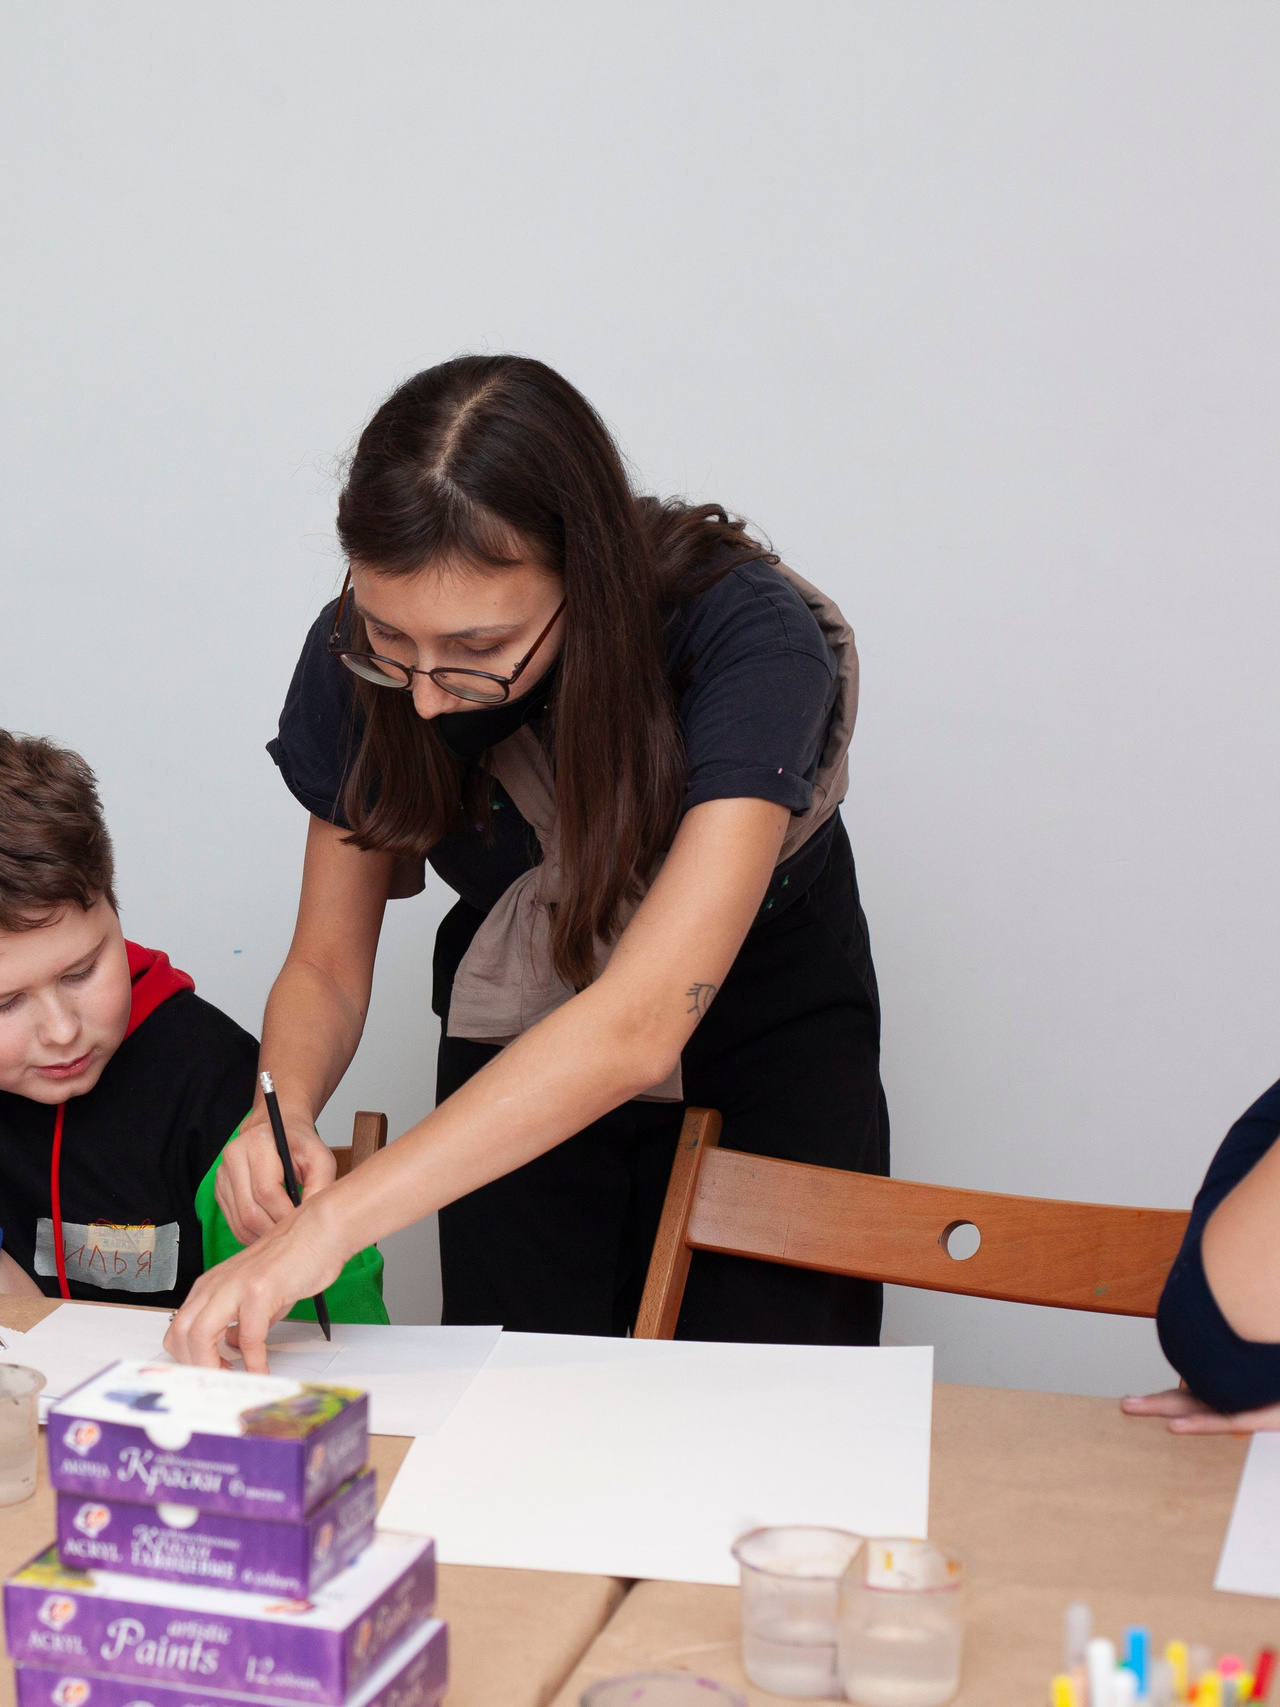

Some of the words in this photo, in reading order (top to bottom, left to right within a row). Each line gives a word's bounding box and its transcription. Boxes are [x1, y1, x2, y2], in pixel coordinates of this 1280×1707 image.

[117, 1447, 223, 1496] Краски
[100, 1617, 219, 1675] Paints
[245, 1655, 275, 1684] 12
